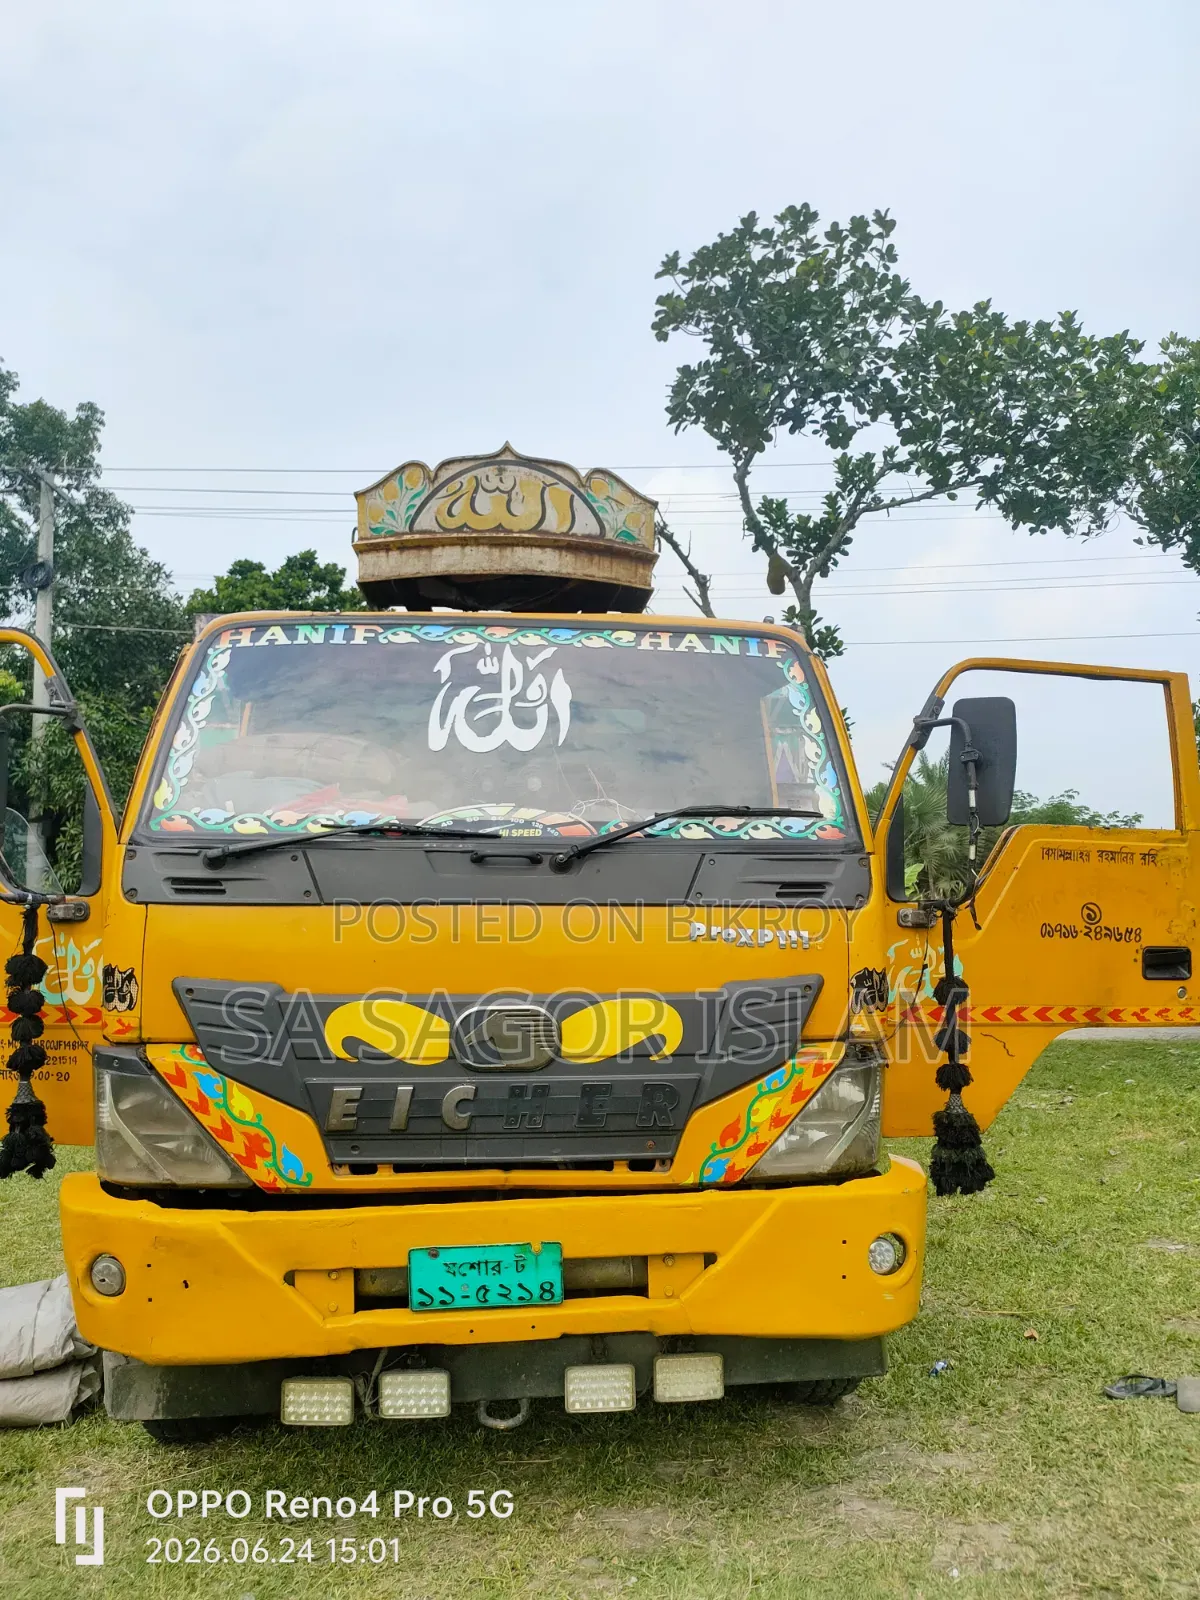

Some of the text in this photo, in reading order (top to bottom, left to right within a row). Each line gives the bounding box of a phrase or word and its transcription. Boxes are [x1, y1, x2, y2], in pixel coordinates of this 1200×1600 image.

[215, 624, 382, 648] HANIF
[637, 631, 787, 658] HANIF
[511, 828, 542, 837] SPEED
[531, 821, 543, 829] 120
[324, 1082, 680, 1131] EICHER
[417, 1281, 555, 1307] ১১-৫২১৪
